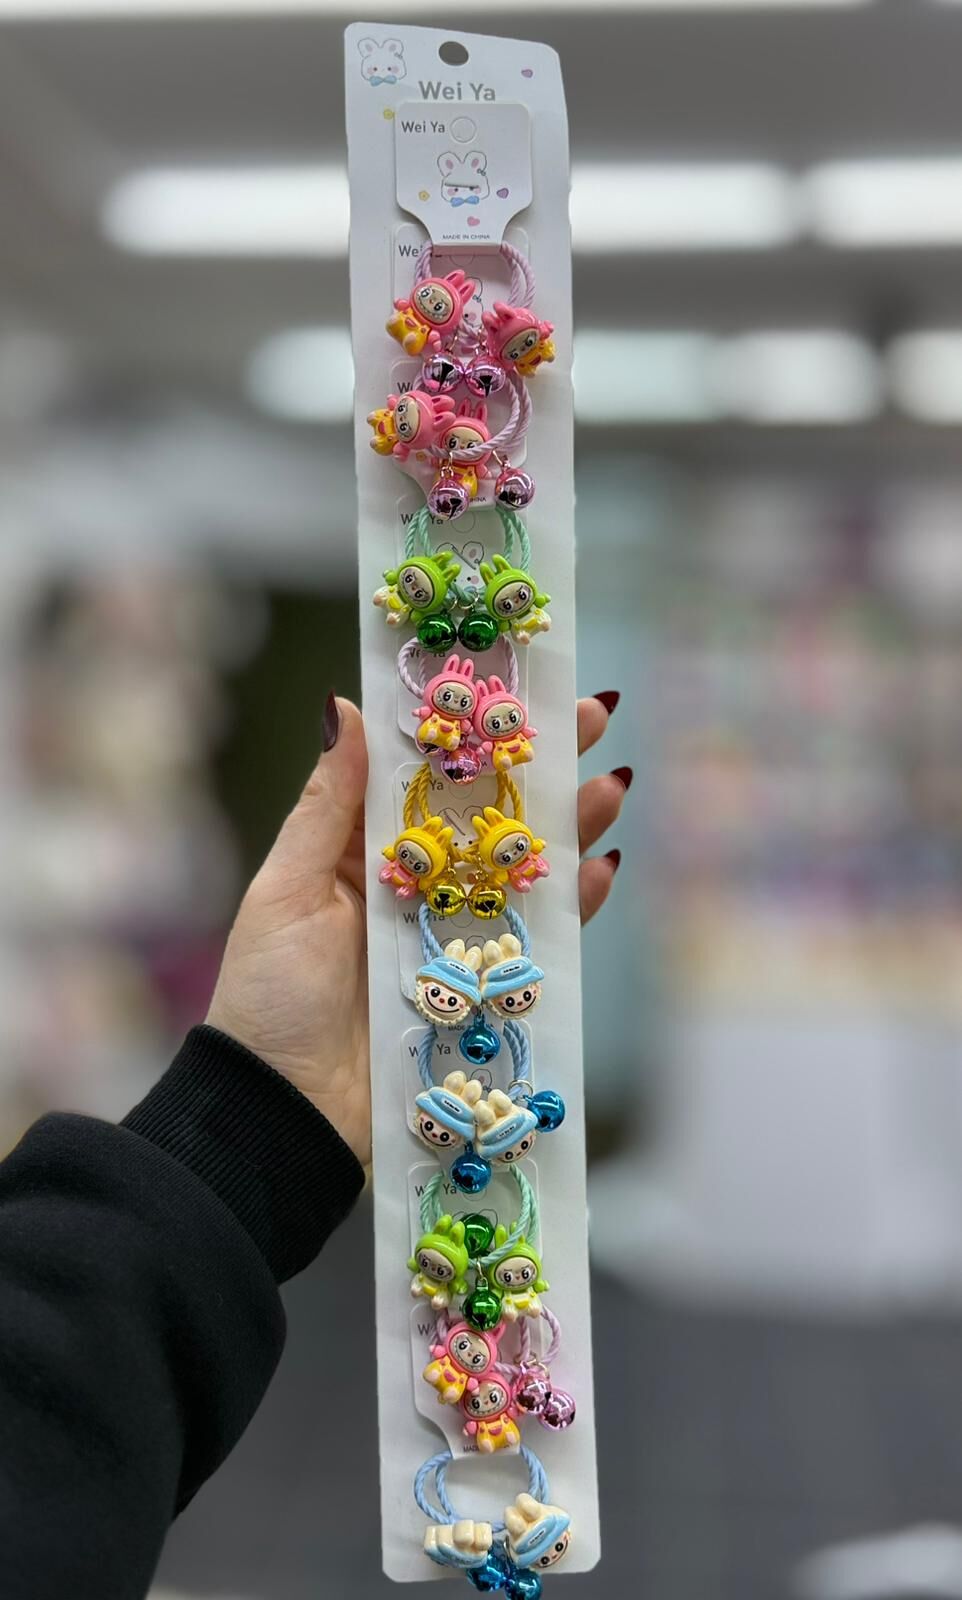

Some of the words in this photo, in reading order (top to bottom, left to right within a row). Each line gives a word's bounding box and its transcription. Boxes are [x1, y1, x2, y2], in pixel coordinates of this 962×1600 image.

[418, 80, 462, 100] Wei
[469, 82, 496, 101] Ya
[401, 120, 426, 133] Wei
[431, 121, 445, 133] Ya
[429, 780, 444, 791] Ya
[436, 1044, 450, 1056] Ya
[443, 1183, 457, 1195] Ya
